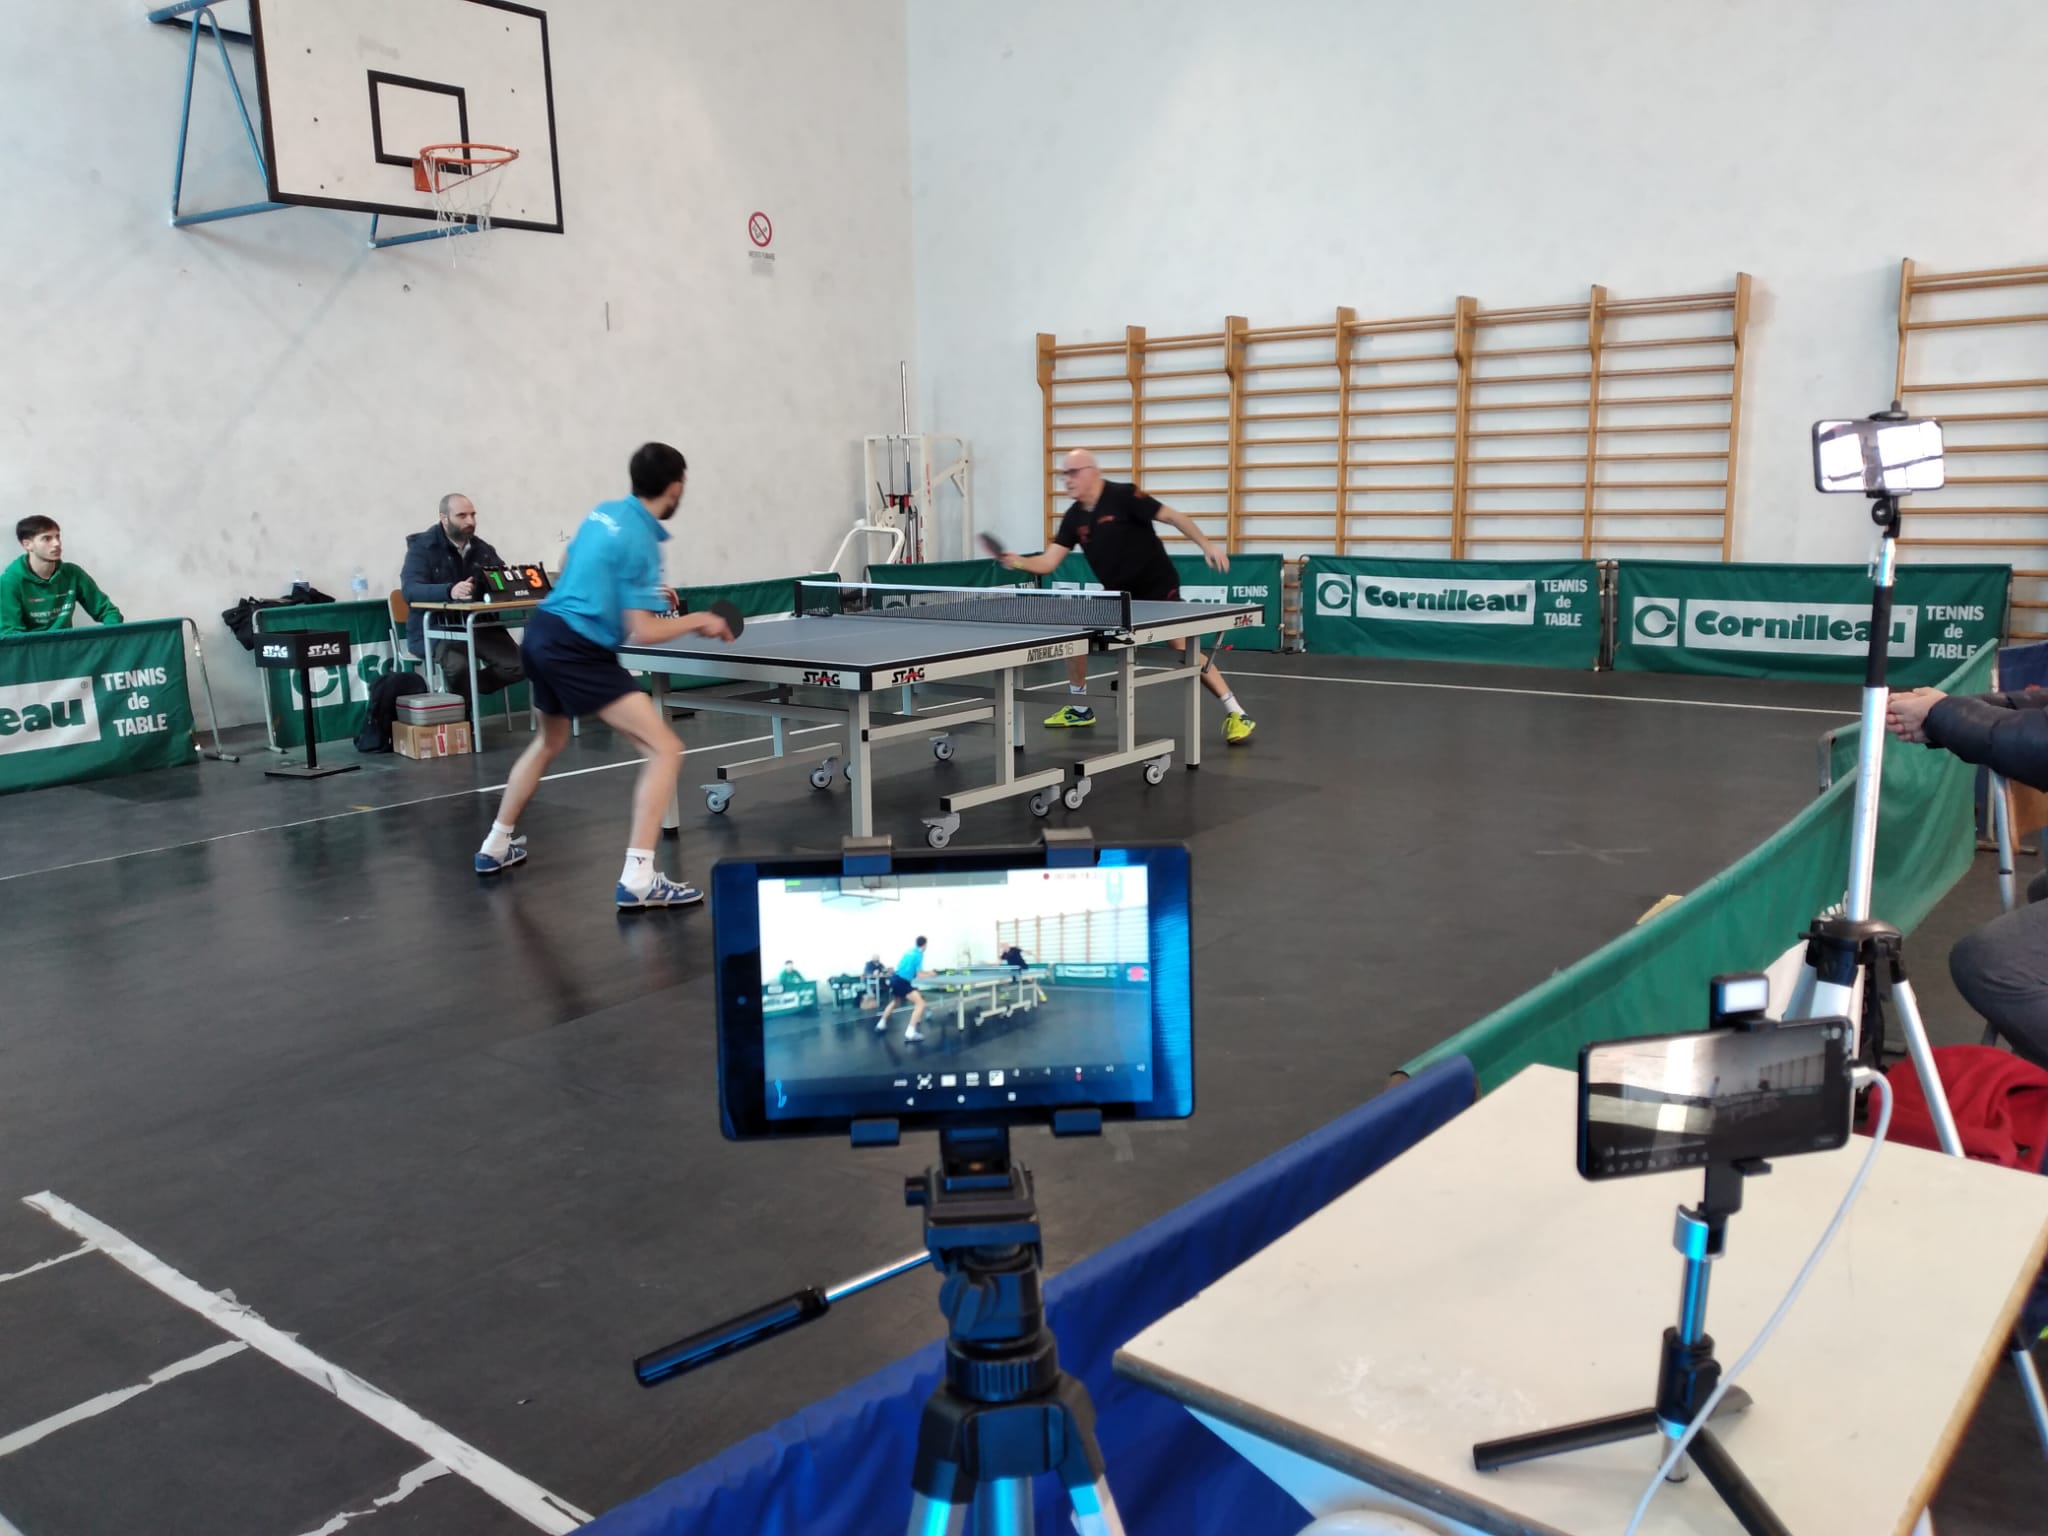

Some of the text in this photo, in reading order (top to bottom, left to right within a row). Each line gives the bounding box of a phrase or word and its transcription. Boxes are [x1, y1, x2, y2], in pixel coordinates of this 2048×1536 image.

[490, 571, 504, 590] 1
[525, 568, 543, 588] 3
[1541, 579, 1588, 593] TENNIS
[1232, 585, 1269, 598] TENNIS
[1365, 585, 1528, 612] Cornilleau
[1555, 595, 1571, 609] de
[1233, 614, 1253, 627] STAG
[1543, 612, 1583, 626] TABLE
[1925, 605, 1985, 621] TENNIS
[1943, 624, 1964, 639] de
[262, 645, 289, 658] STAG
[307, 643, 341, 657] STAG
[101, 667, 167, 691] TENNIS
[802, 671, 840, 686] STAG
[891, 667, 925, 684] STAG
[127, 692, 150, 710] de
[113, 713, 168, 737] TABLE
